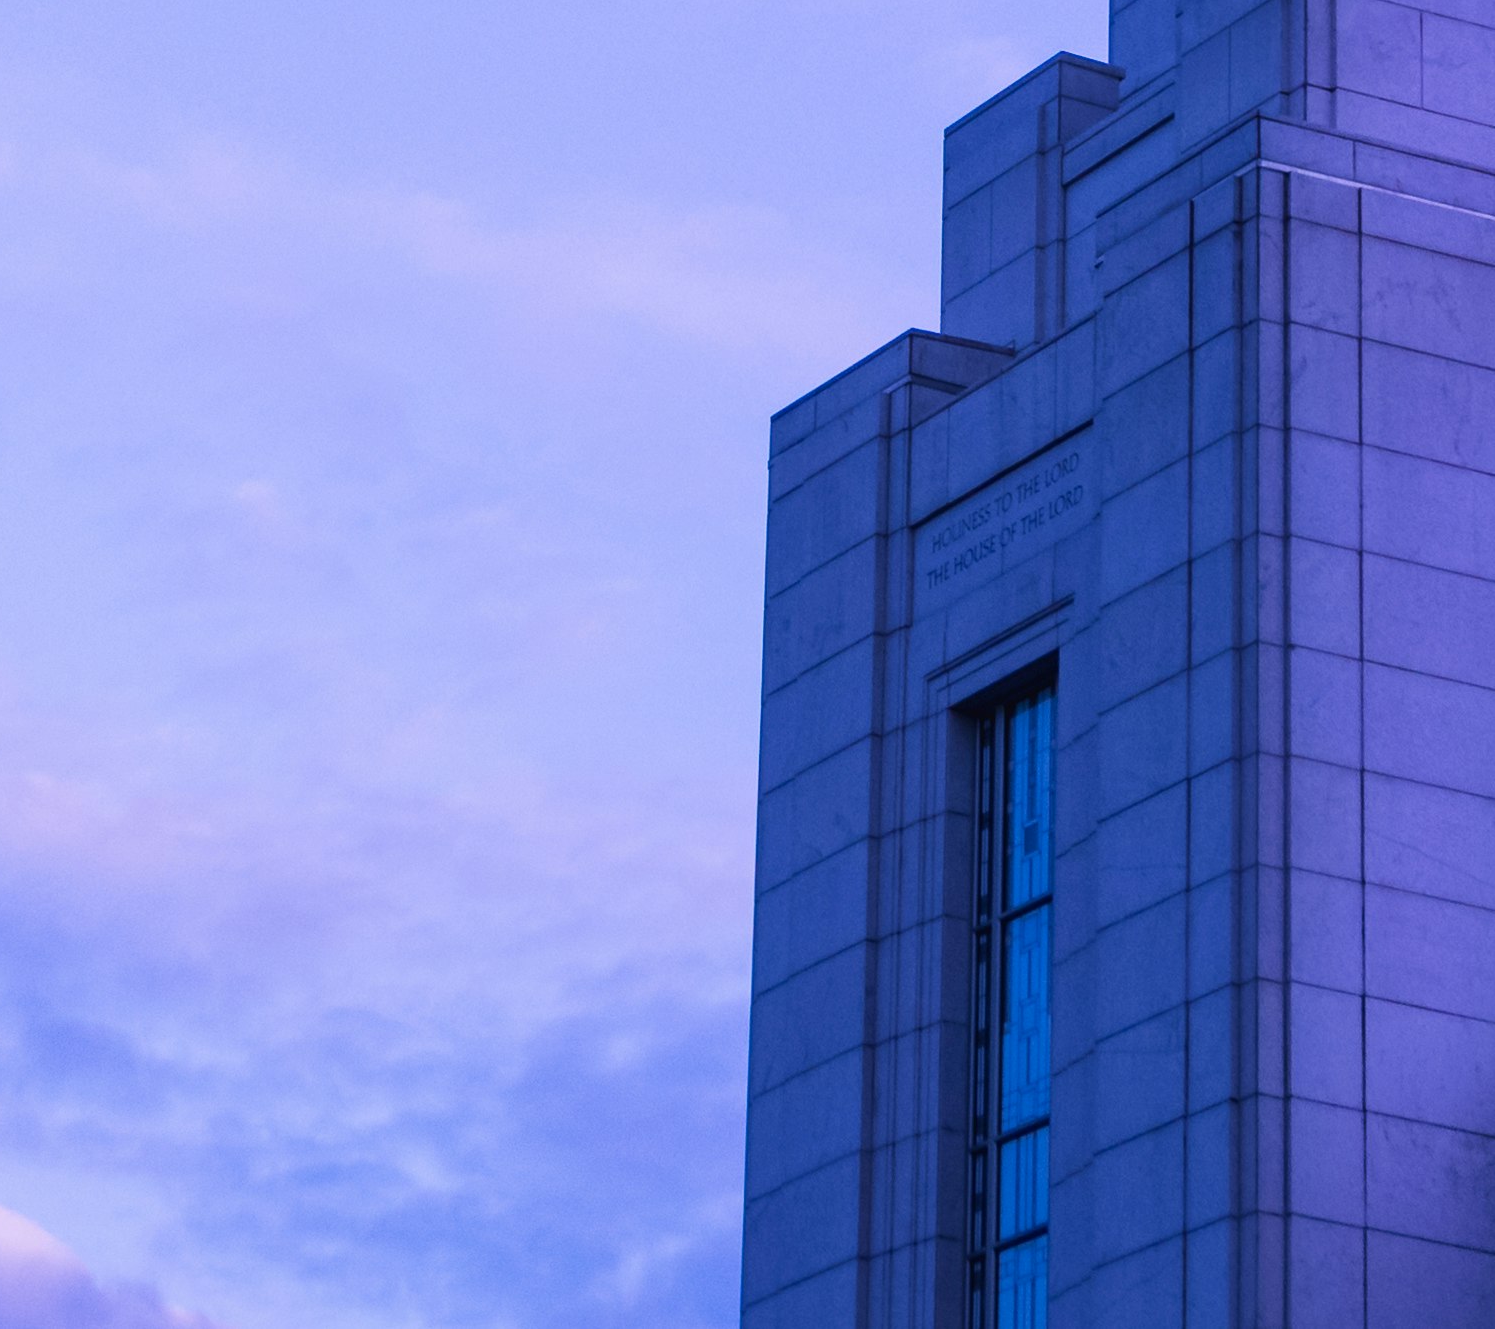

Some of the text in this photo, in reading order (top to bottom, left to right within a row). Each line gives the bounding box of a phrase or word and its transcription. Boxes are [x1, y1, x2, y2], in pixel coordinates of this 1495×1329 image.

[994, 492, 1013, 516] TO
[1016, 475, 1040, 503] THE
[1044, 452, 1080, 488] LORD
[926, 485, 1084, 590] THE HOUSE OF THE LORD
